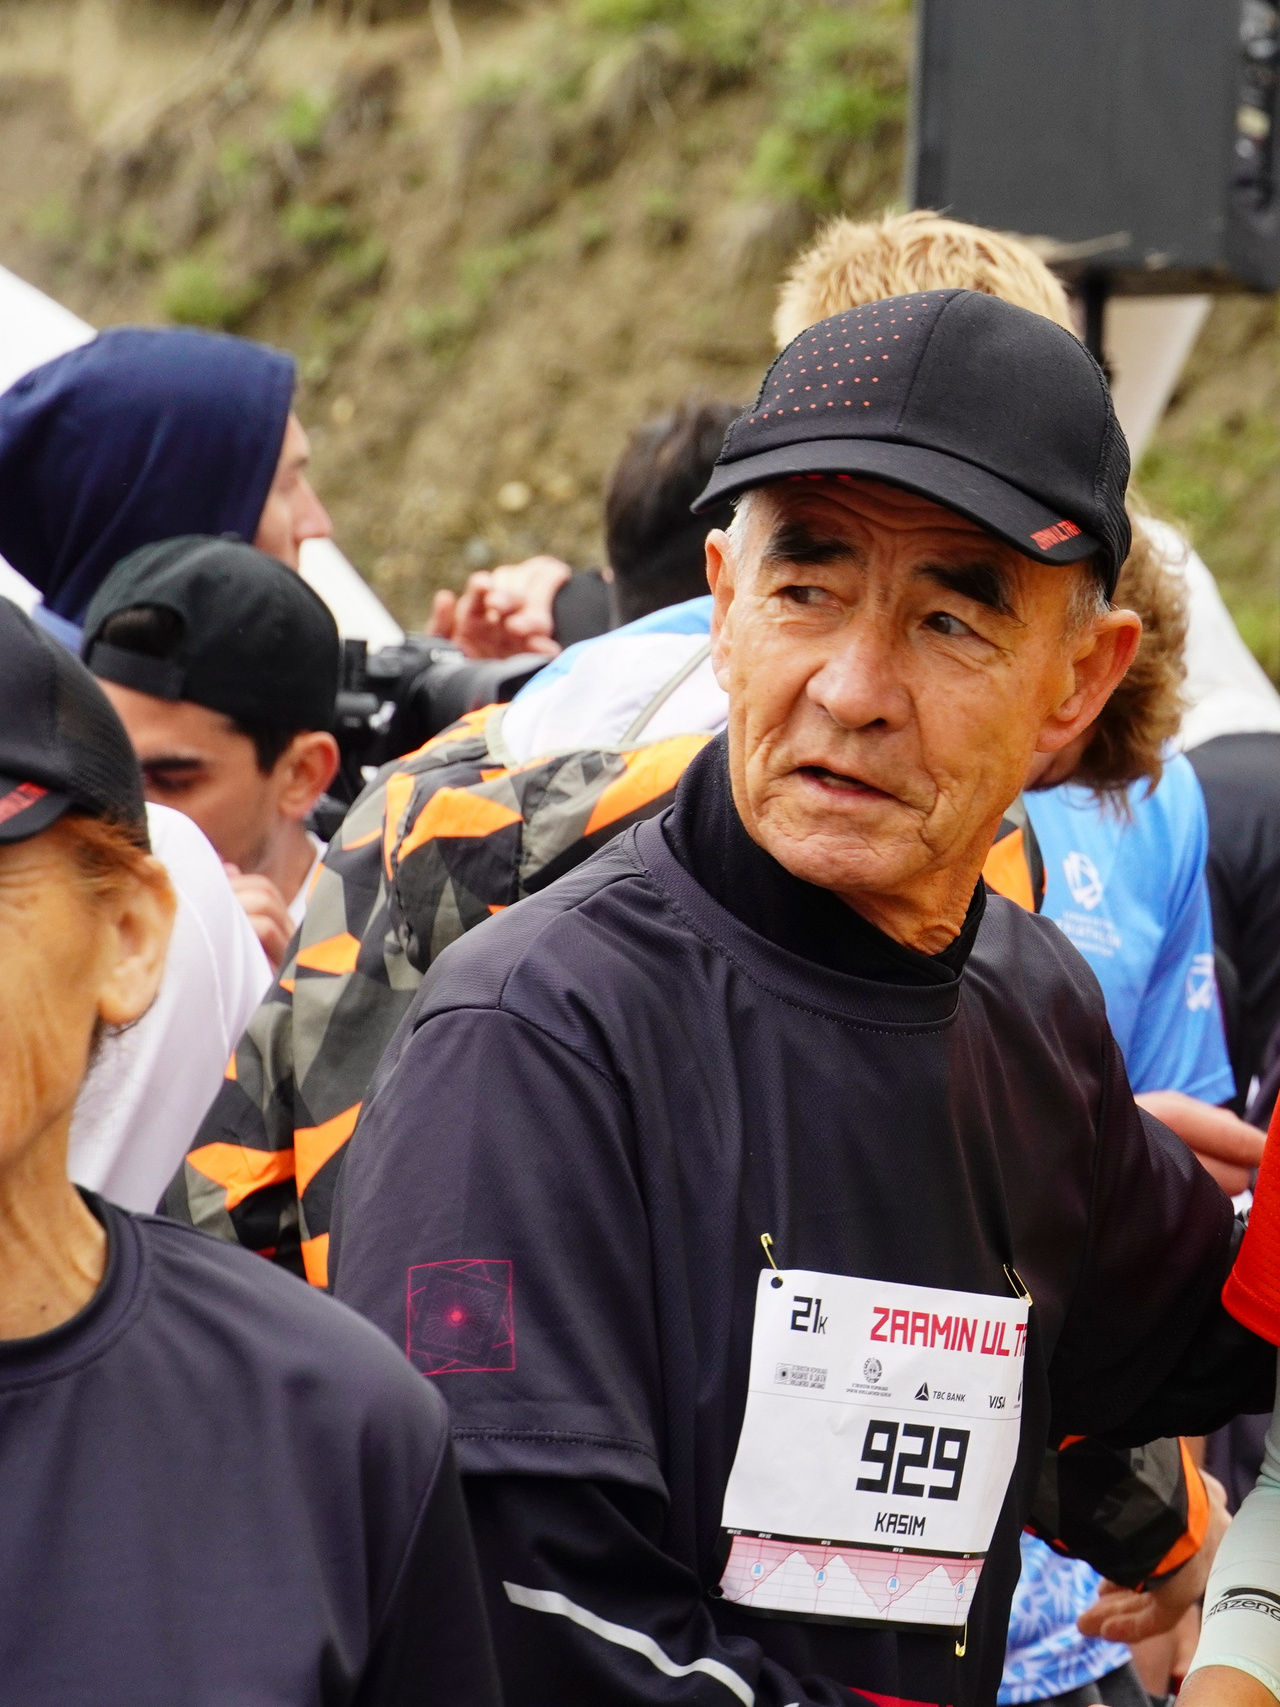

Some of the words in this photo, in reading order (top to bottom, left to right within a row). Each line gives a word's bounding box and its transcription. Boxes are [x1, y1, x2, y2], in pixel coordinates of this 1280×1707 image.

[870, 1306, 978, 1352] ZAAMIN
[933, 1391, 945, 1400] TBC
[947, 1392, 966, 1402] BANK
[855, 1419, 971, 1501] 929
[874, 1512, 926, 1536] KASIM
